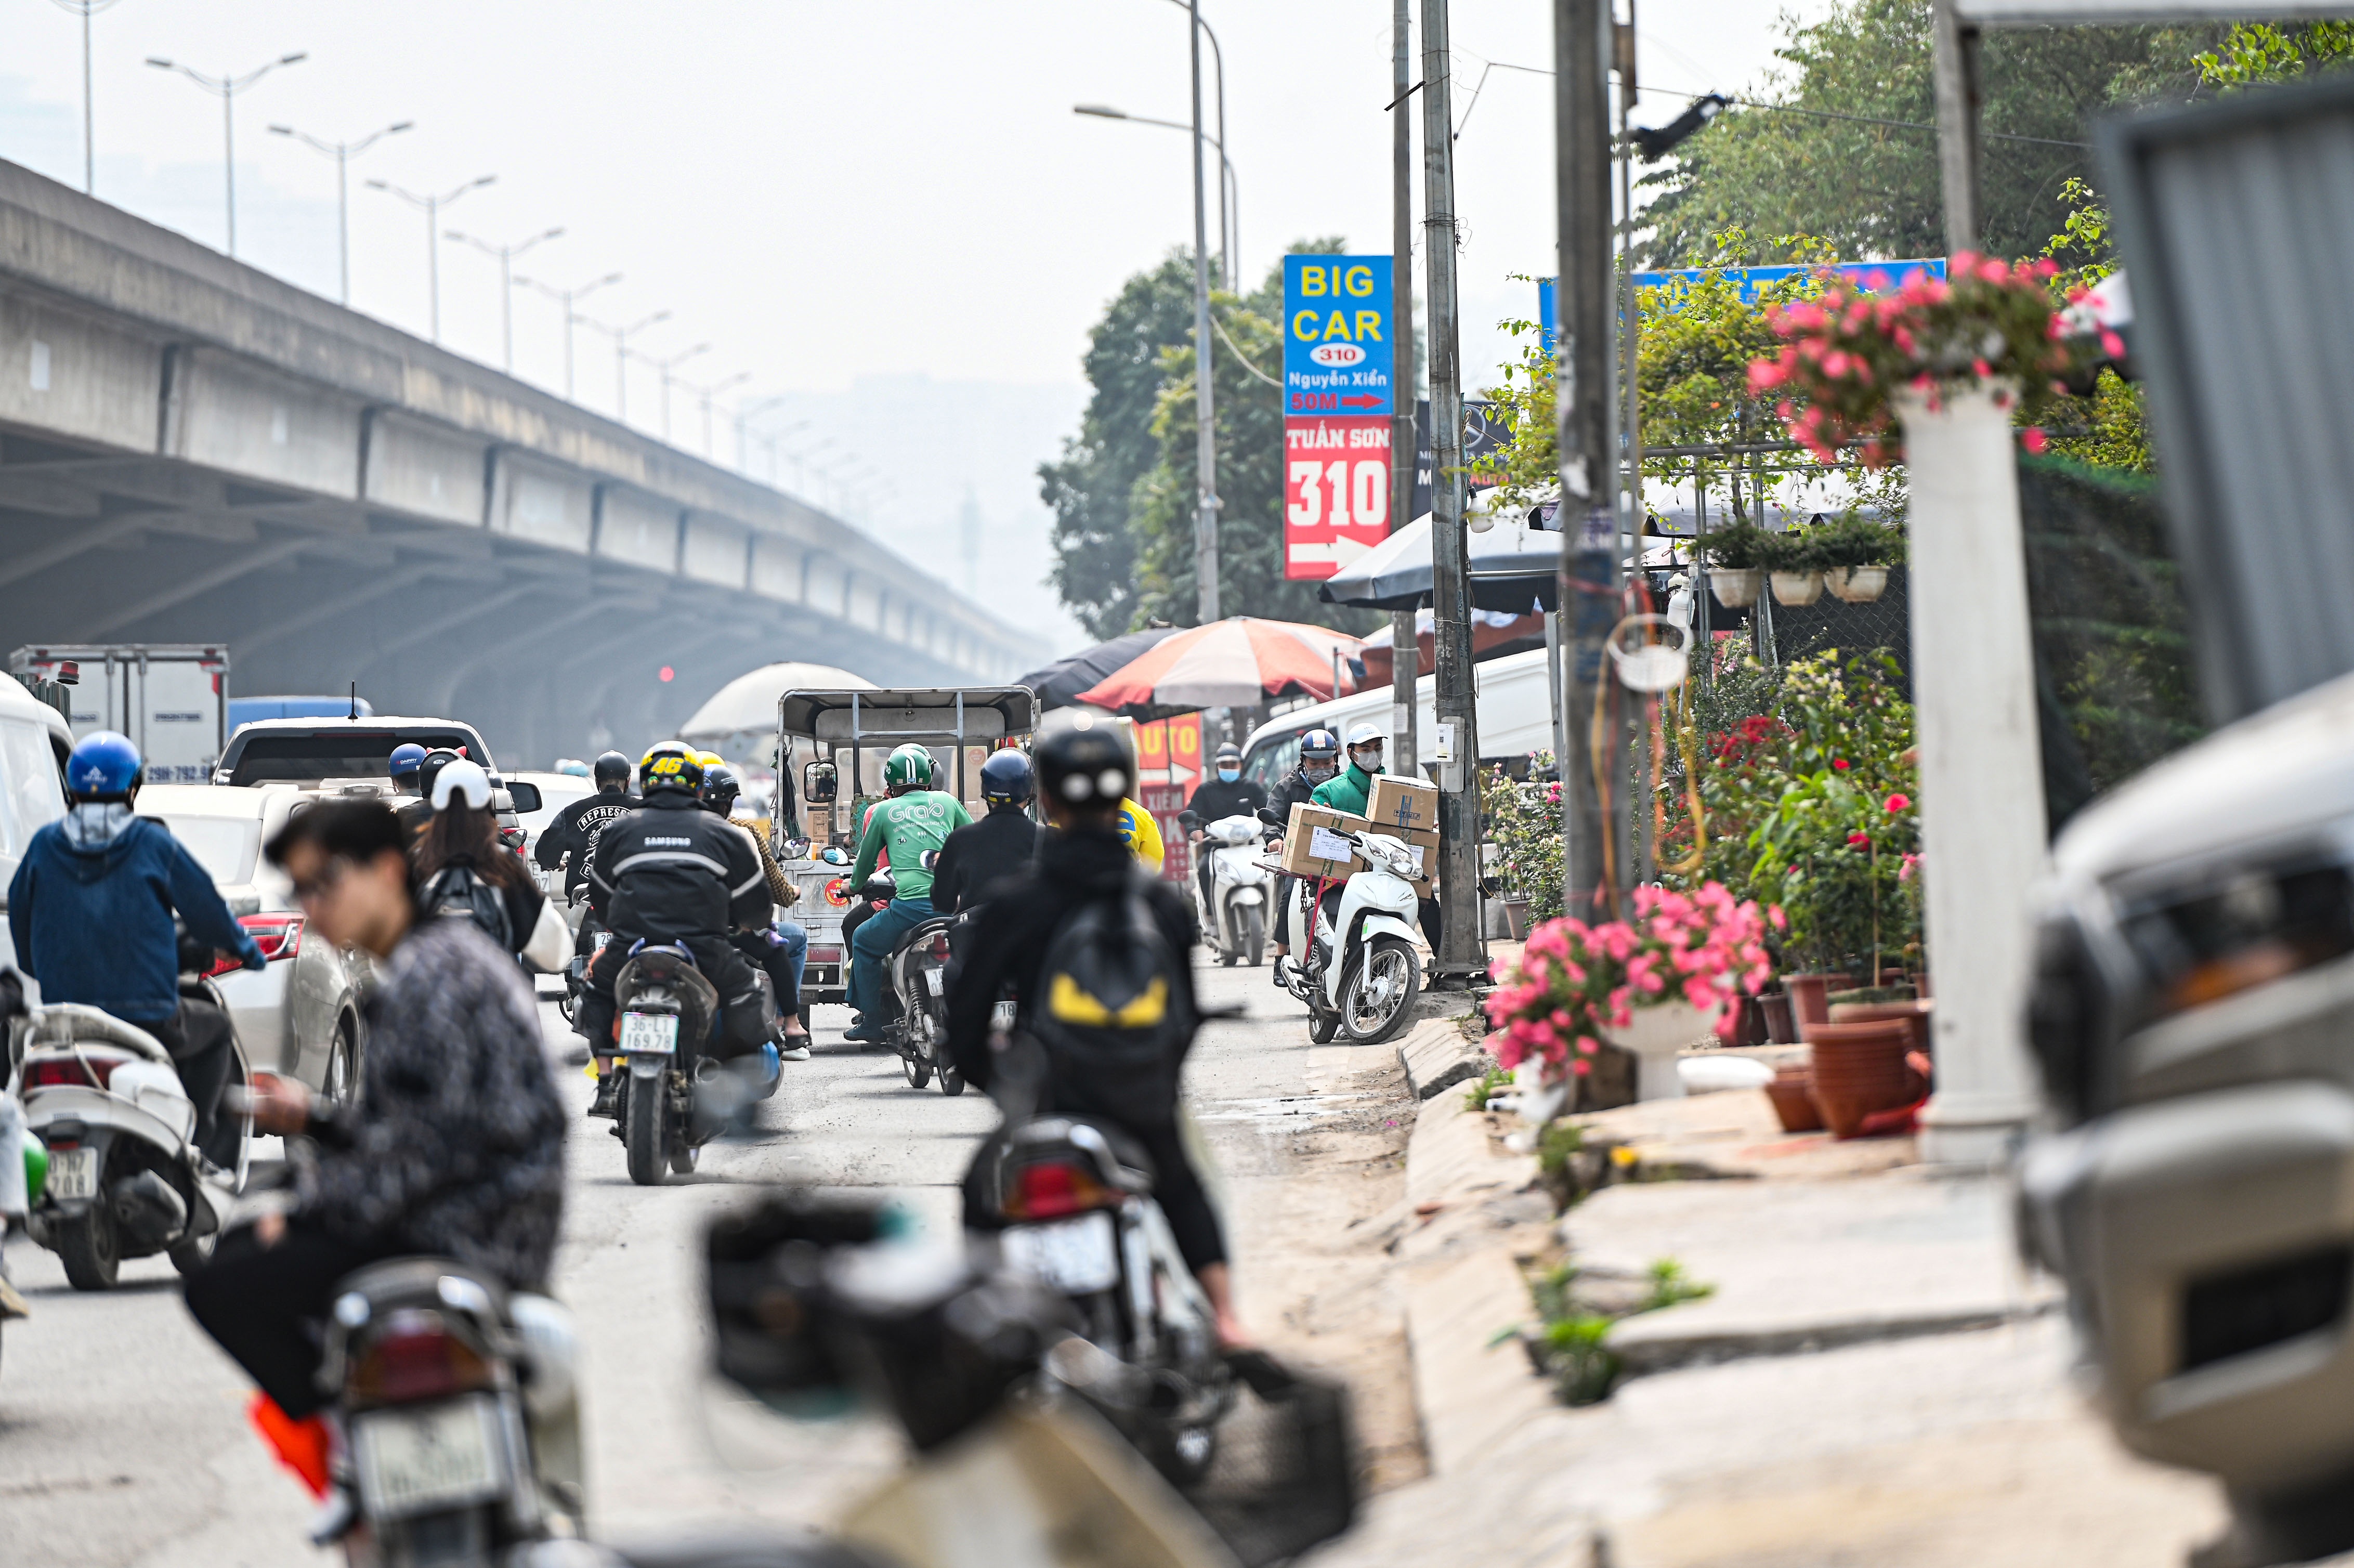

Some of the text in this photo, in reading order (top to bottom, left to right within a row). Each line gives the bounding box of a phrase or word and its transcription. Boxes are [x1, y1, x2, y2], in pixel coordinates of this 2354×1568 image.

[1301, 265, 1374, 297] BIG
[1292, 309, 1383, 342] CAR
[1319, 349, 1356, 361] 310
[1289, 368, 1388, 389] Nguyễn Xiển
[1291, 393, 1337, 410] 50M
[1287, 419, 1391, 449] TUẤN SƠN
[1288, 460, 1388, 526] 310
[651, 757, 684, 774] 46
[888, 798, 944, 822] Grab
[644, 836, 691, 847] SAMSUNG
[1001, 1003, 1016, 1016] 18
[632, 1017, 668, 1033] 36-L1
[626, 1033, 672, 1049] 169.78
